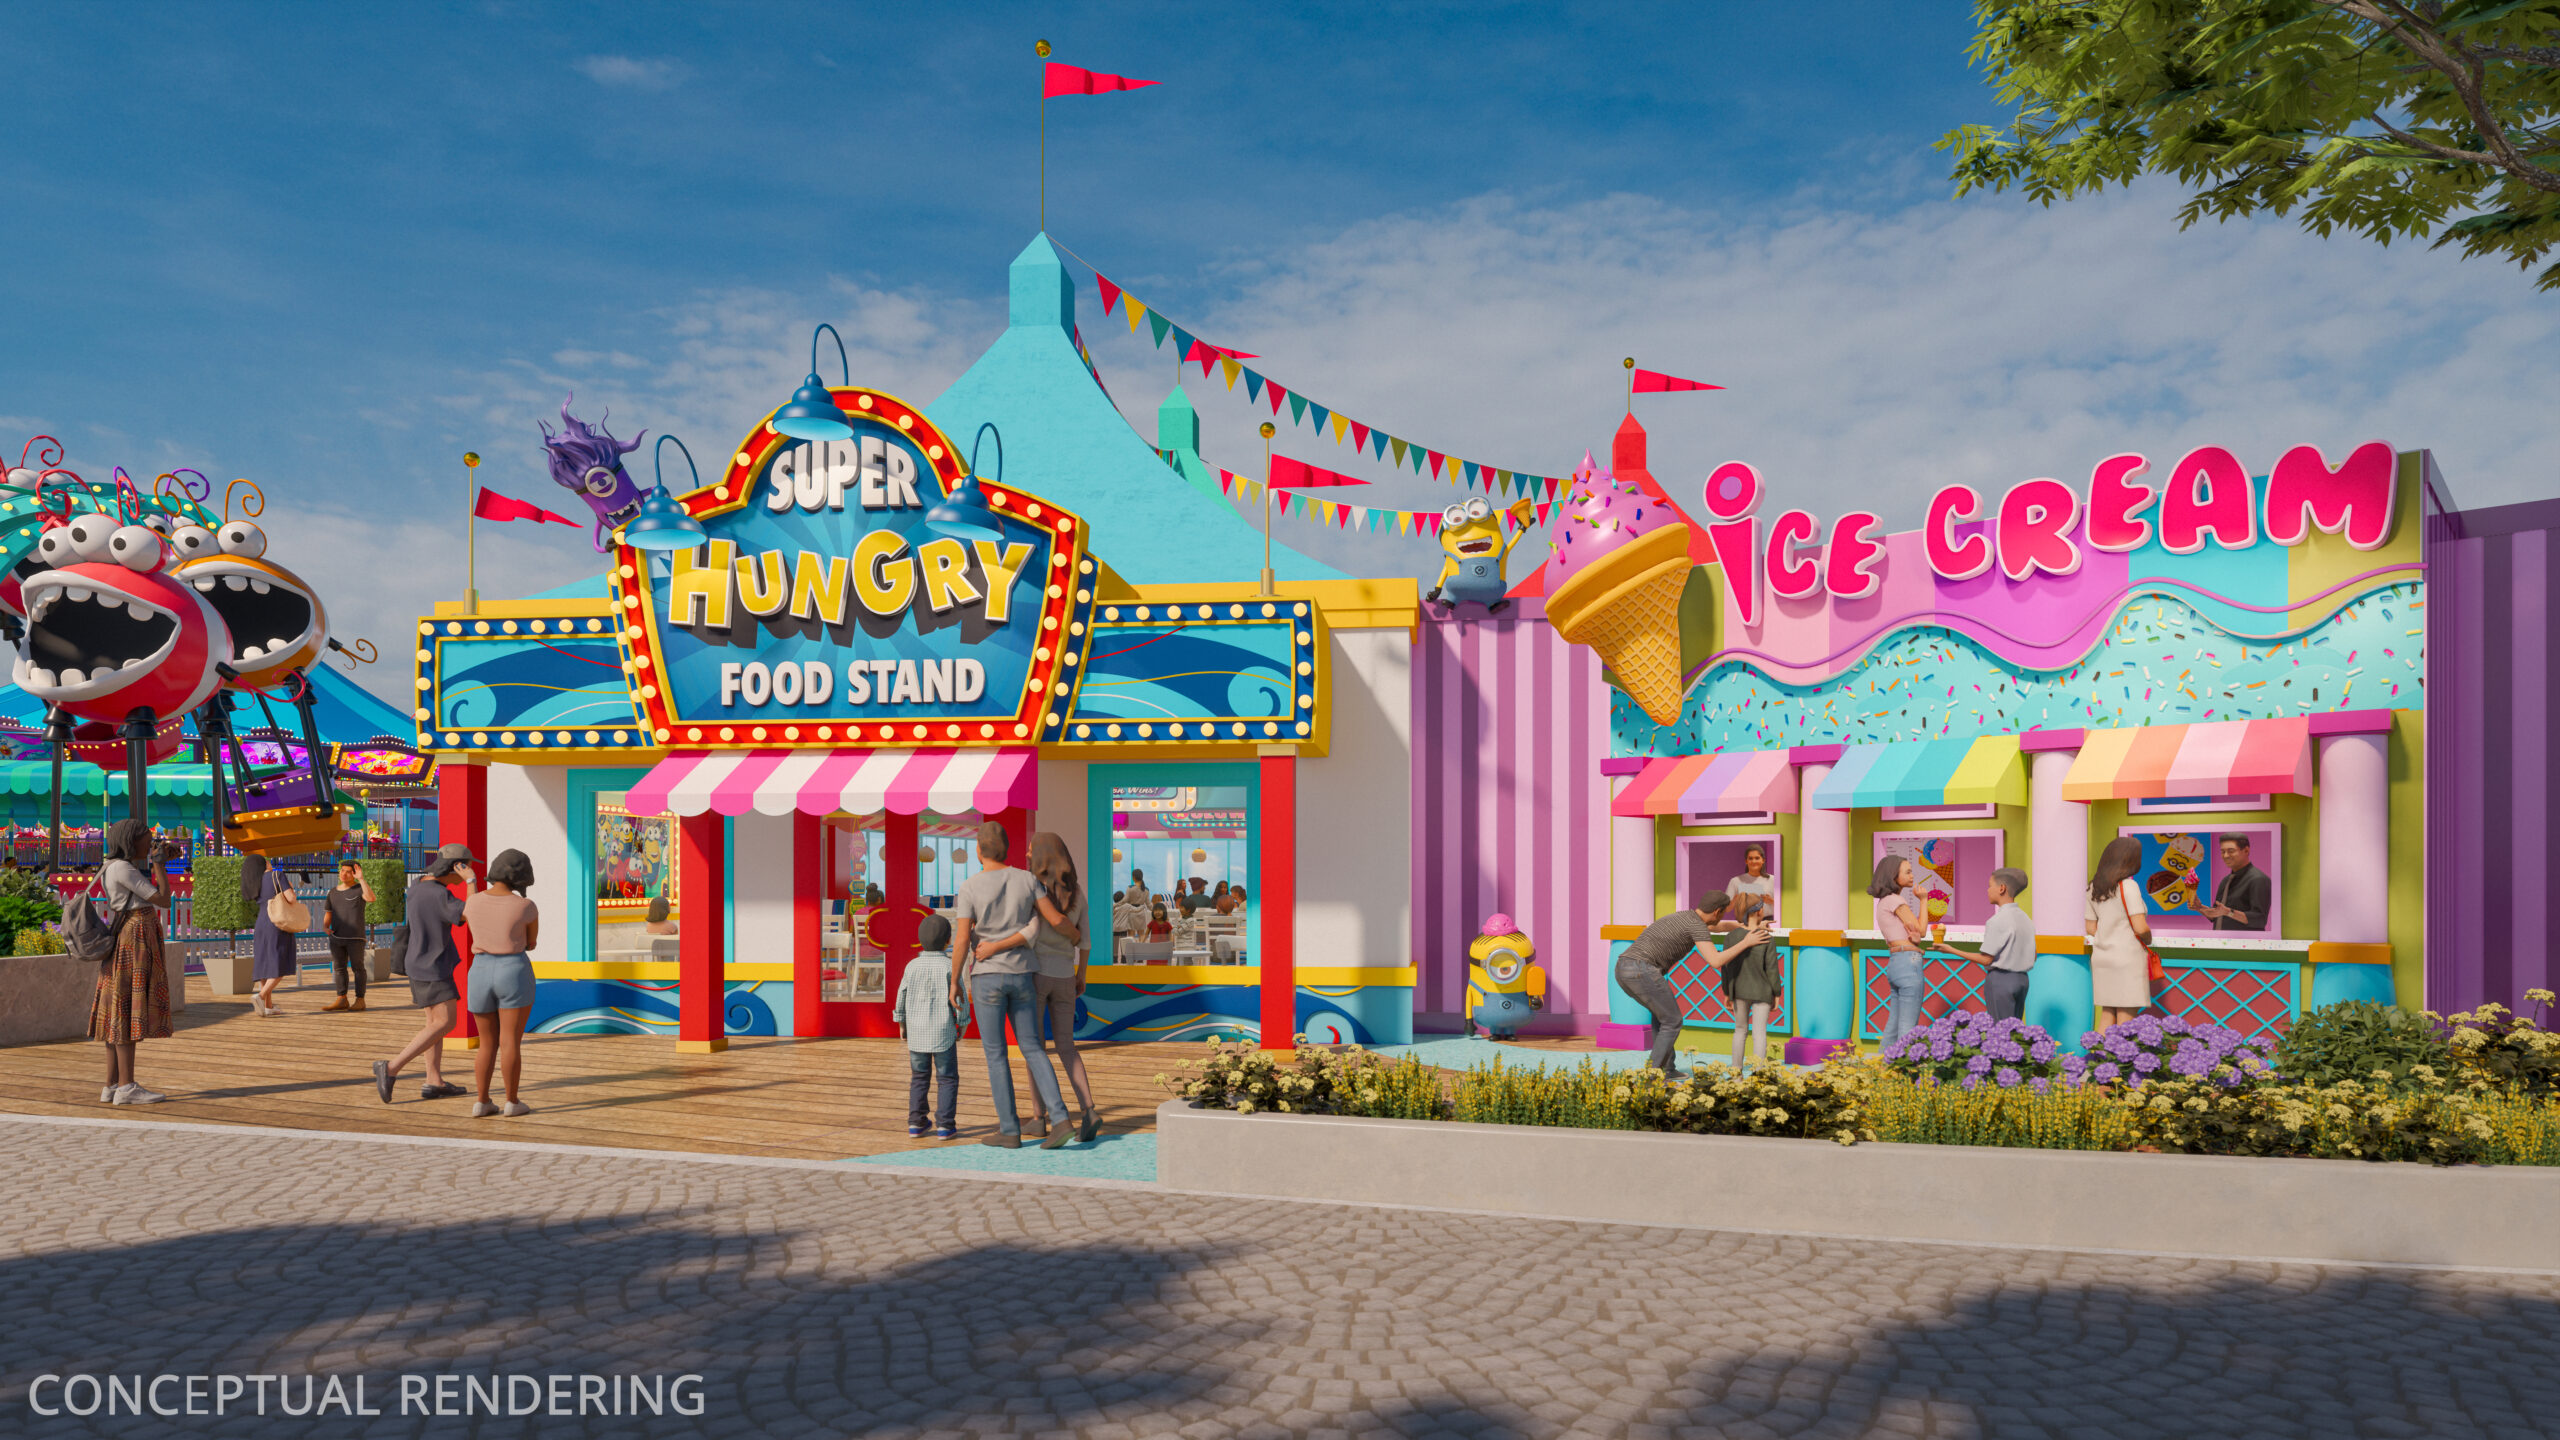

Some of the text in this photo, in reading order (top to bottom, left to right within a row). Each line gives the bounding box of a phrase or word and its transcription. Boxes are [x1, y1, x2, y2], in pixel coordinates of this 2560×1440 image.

[767, 436, 923, 511] SUPER
[1923, 440, 2399, 581] CREAM
[668, 529, 1036, 629] HUNGRY
[720, 658, 986, 706] FOOD STAND
